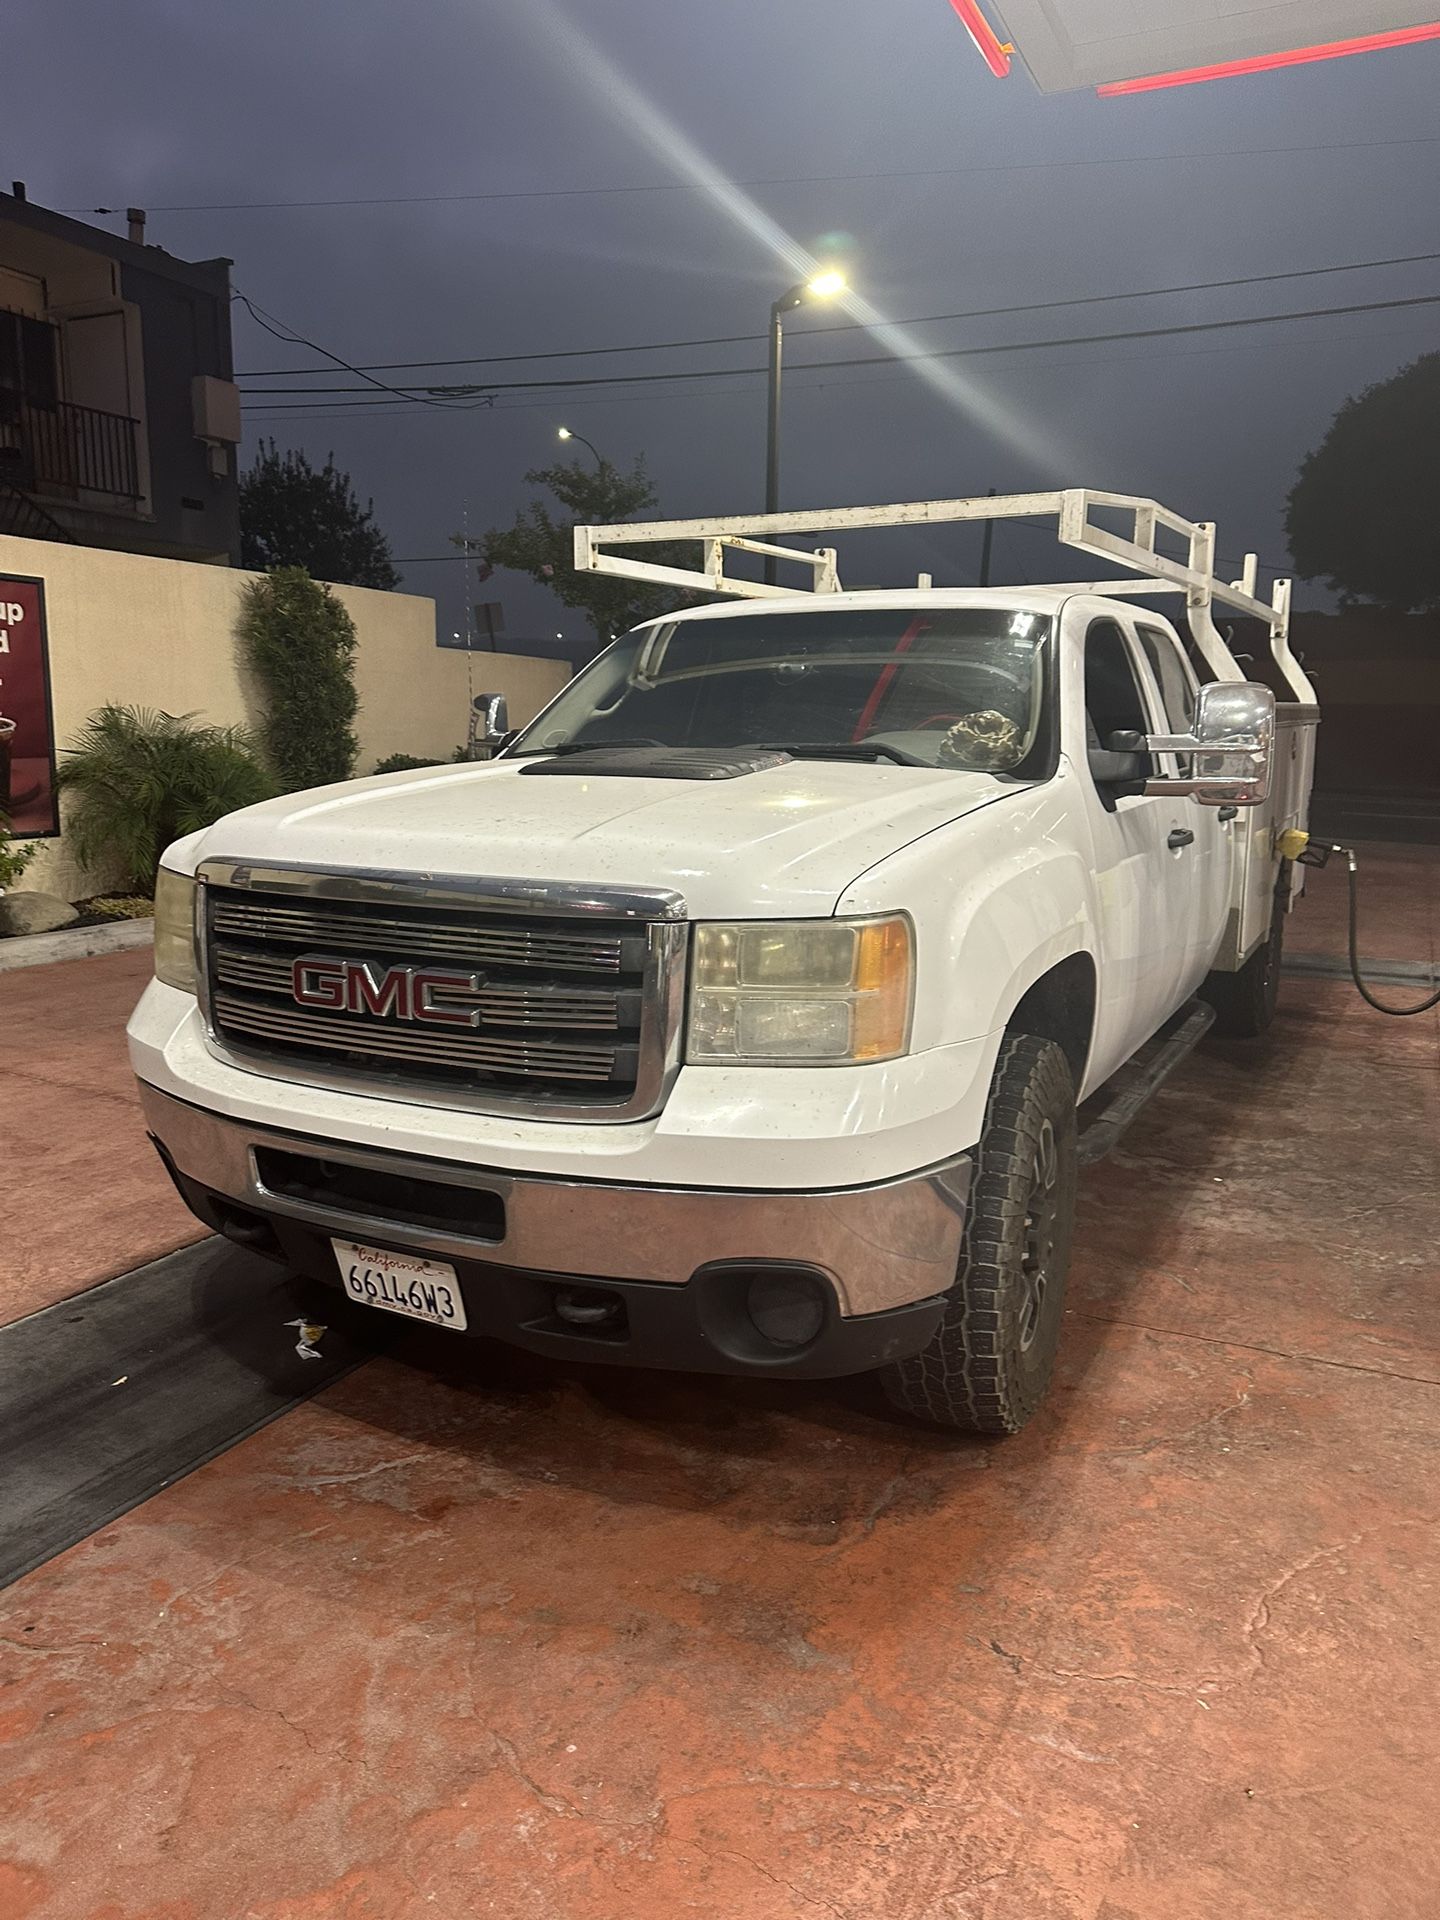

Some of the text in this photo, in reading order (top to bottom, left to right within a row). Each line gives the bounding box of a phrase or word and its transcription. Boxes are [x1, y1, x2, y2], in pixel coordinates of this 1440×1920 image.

[292, 953, 484, 1028] GMC
[358, 1247, 434, 1276] California
[349, 1265, 455, 1318] 66146W3
